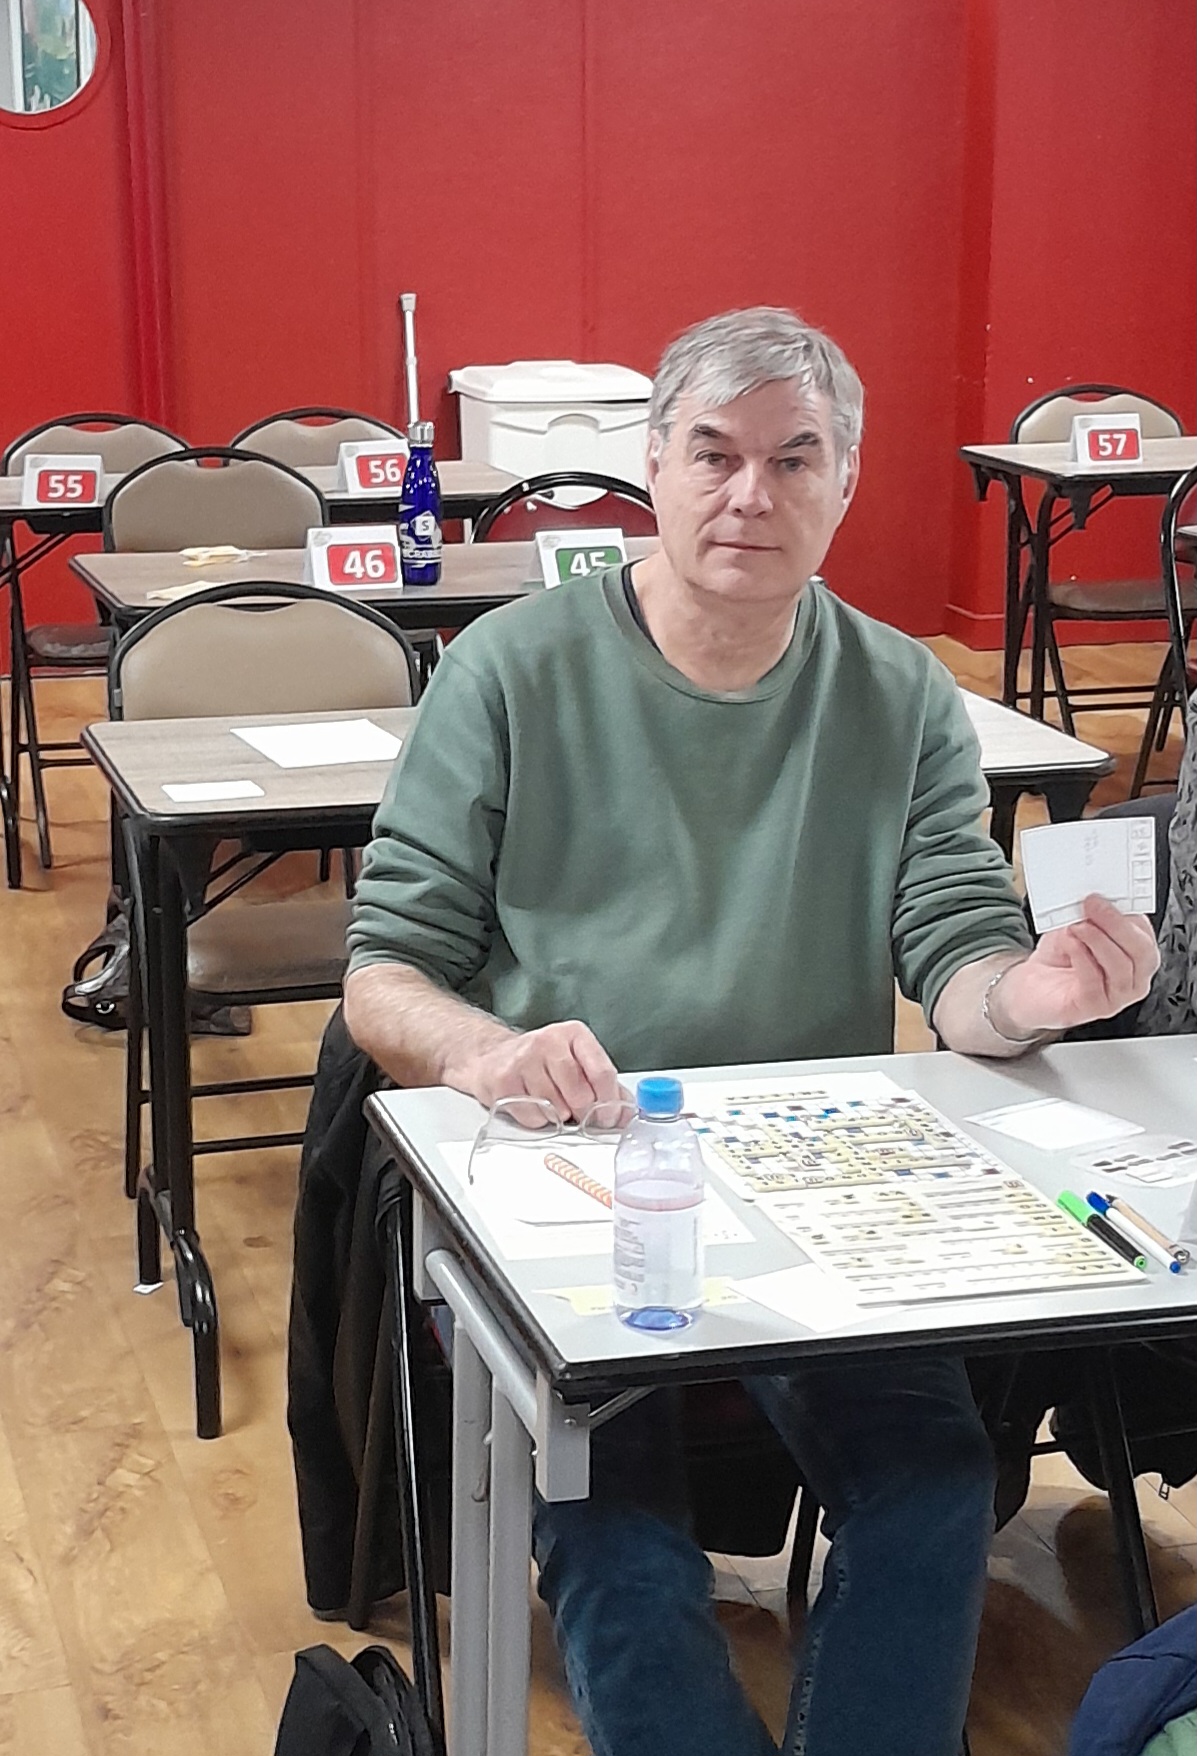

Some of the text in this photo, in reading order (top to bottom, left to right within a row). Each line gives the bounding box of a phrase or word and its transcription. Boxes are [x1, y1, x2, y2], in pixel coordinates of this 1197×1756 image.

[1098, 434, 1127, 456] 57
[368, 459, 401, 483] 56
[48, 475, 83, 498] 55
[344, 551, 385, 578] 46
[570, 551, 607, 577] 45
